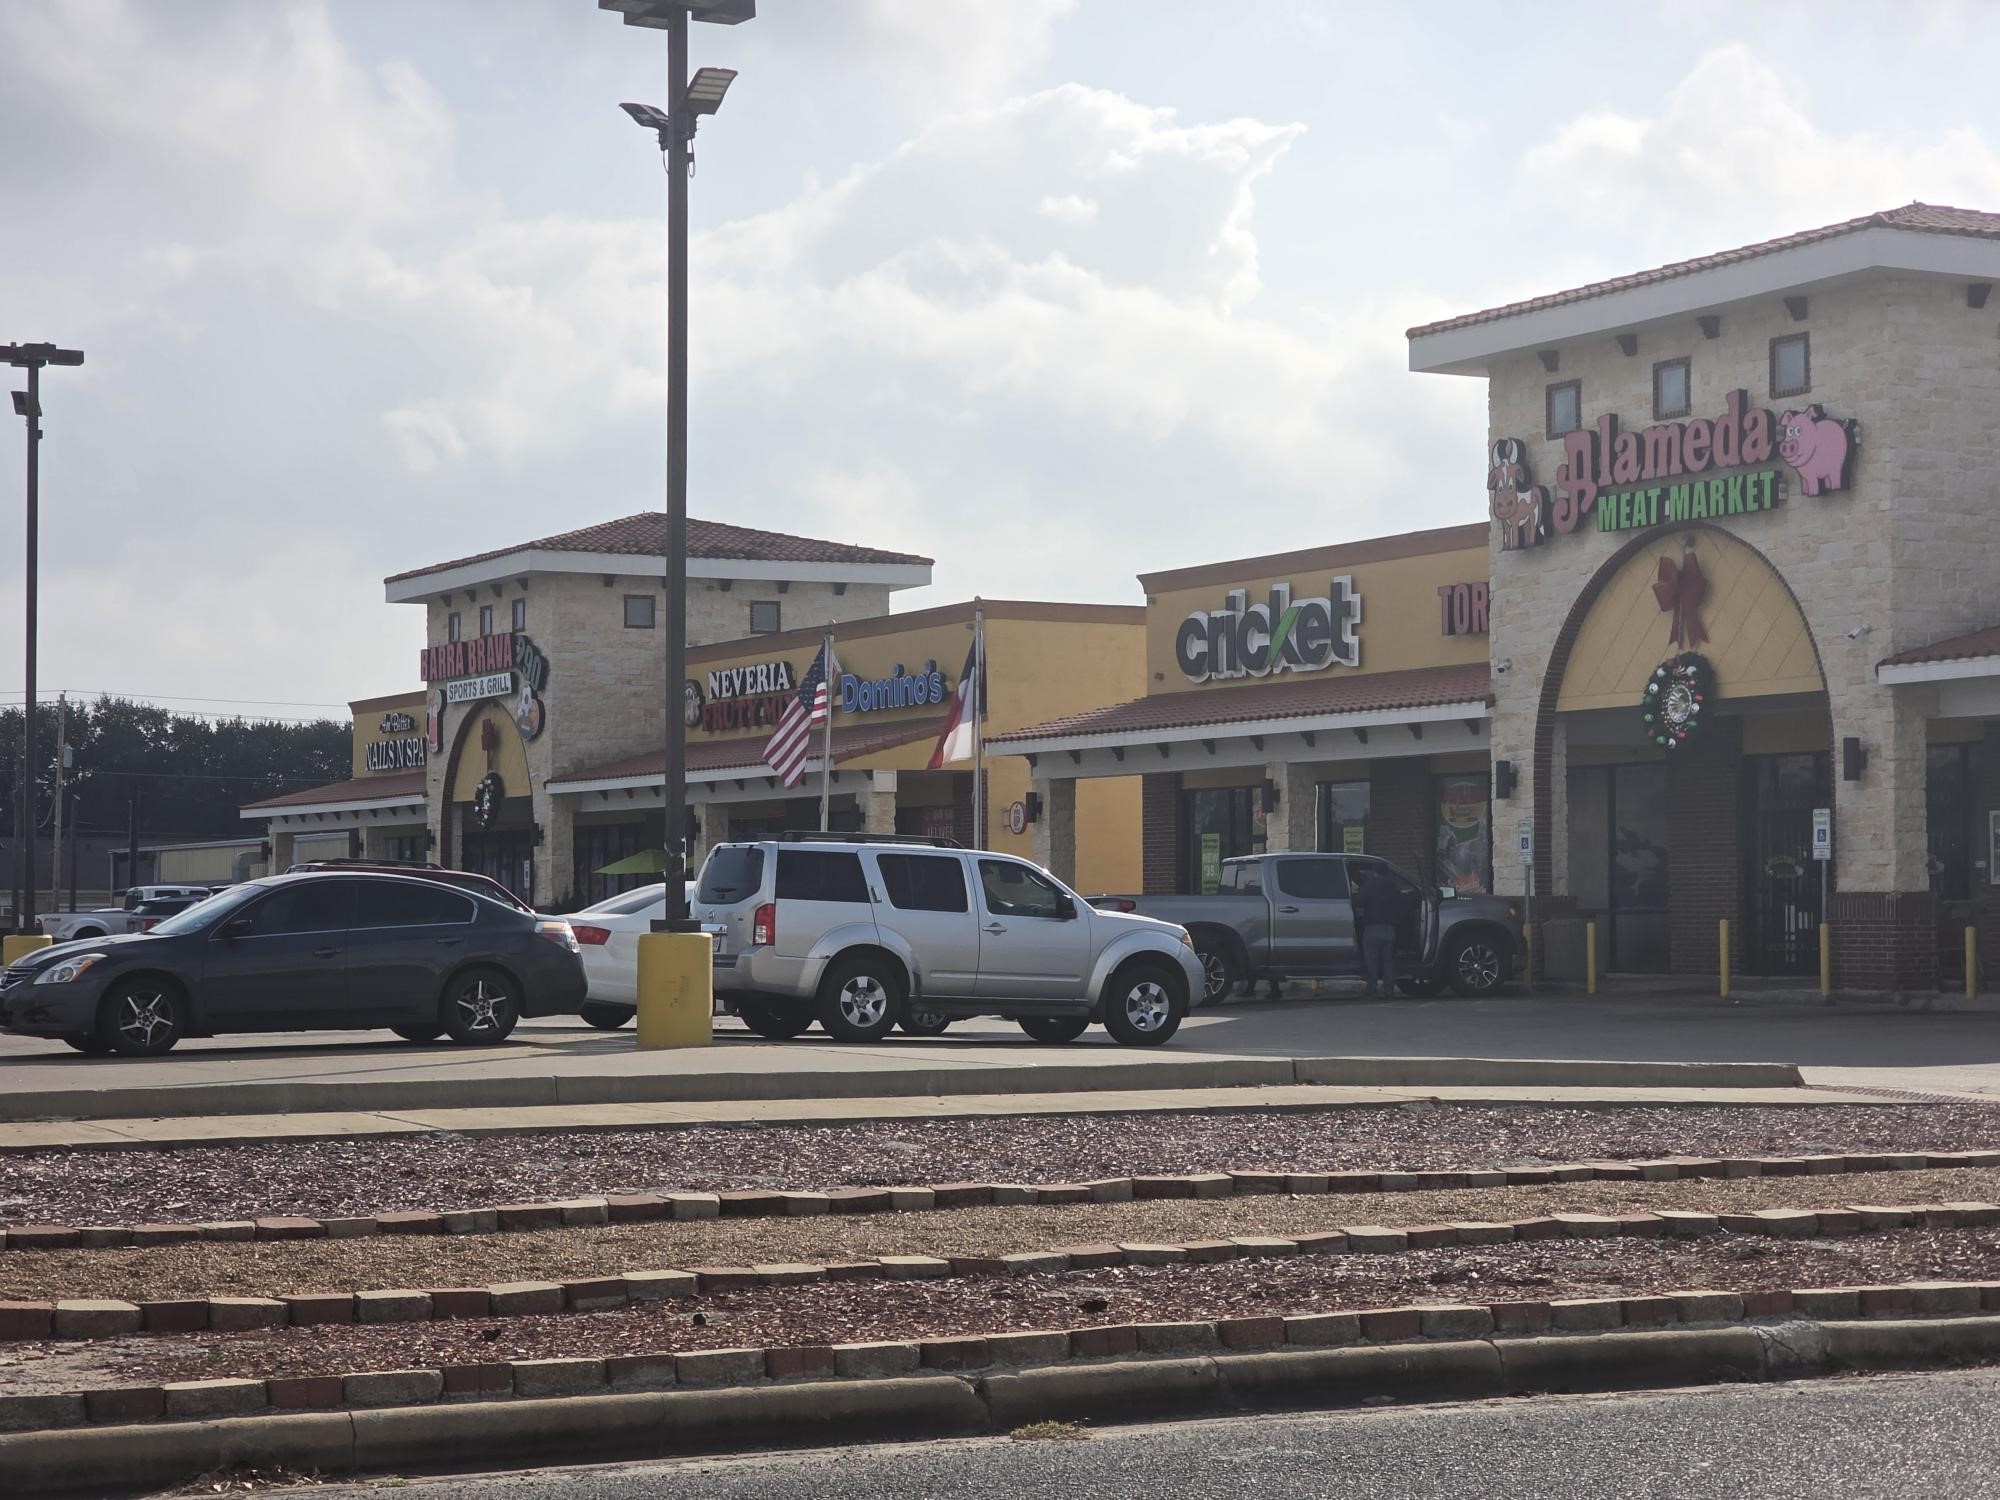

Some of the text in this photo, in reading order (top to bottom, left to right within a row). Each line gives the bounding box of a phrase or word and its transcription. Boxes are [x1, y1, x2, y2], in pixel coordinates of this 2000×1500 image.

[1552, 389, 1773, 534] Alameda
[1597, 471, 1775, 532] MEAT MARKET
[1176, 577, 1360, 683] cricket
[420, 632, 513, 682] BARRA BRAVA
[707, 661, 791, 700] NEVERIA
[448, 675, 510, 700] SPORTS & GRILL
[840, 658, 943, 714] Domino's
[365, 737, 425, 771] NAILS N SPA
